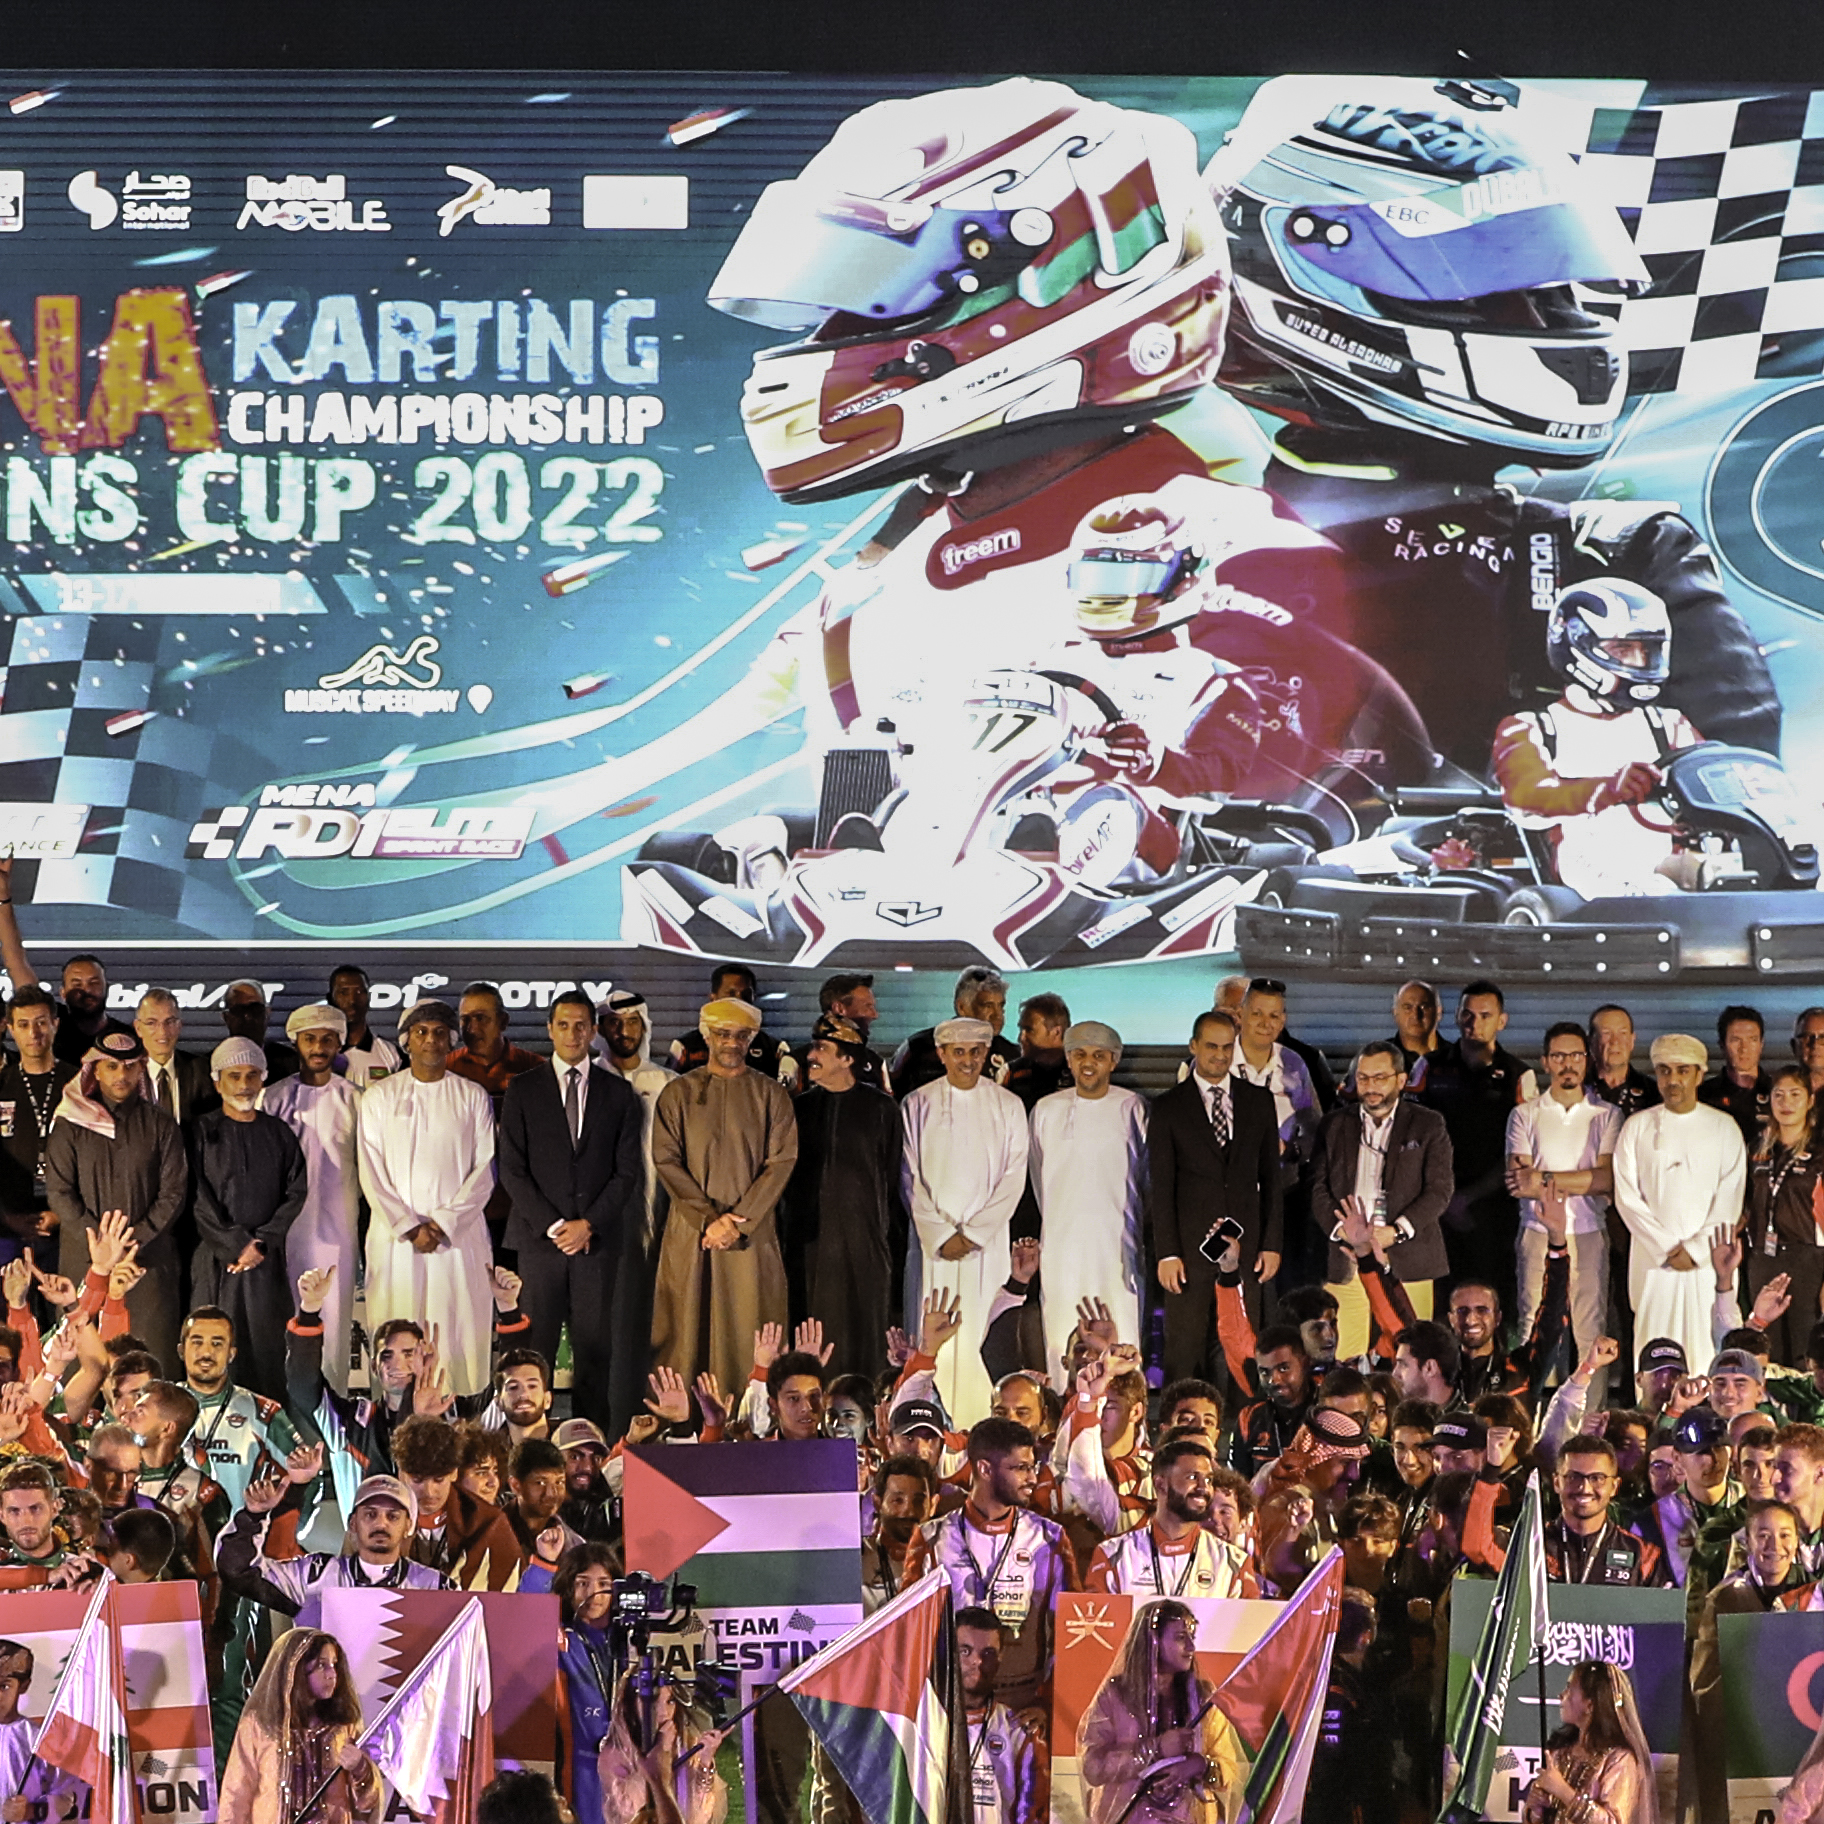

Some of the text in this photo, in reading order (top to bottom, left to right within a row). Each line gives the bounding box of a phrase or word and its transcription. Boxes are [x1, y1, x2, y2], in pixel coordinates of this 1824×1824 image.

[123, 201, 191, 221] Sohar
[236, 200, 392, 231] MOBILE
[1385, 205, 1430, 225] EBC
[229, 295, 662, 386] KARTING
[226, 389, 664, 444] CHAMPIONSHIP
[176, 452, 379, 543] CUP
[412, 452, 664, 544] 2022
[941, 529, 1020, 575] freem
[992, 1590, 1024, 1601] Sohar
[708, 1617, 779, 1636] TEAM
